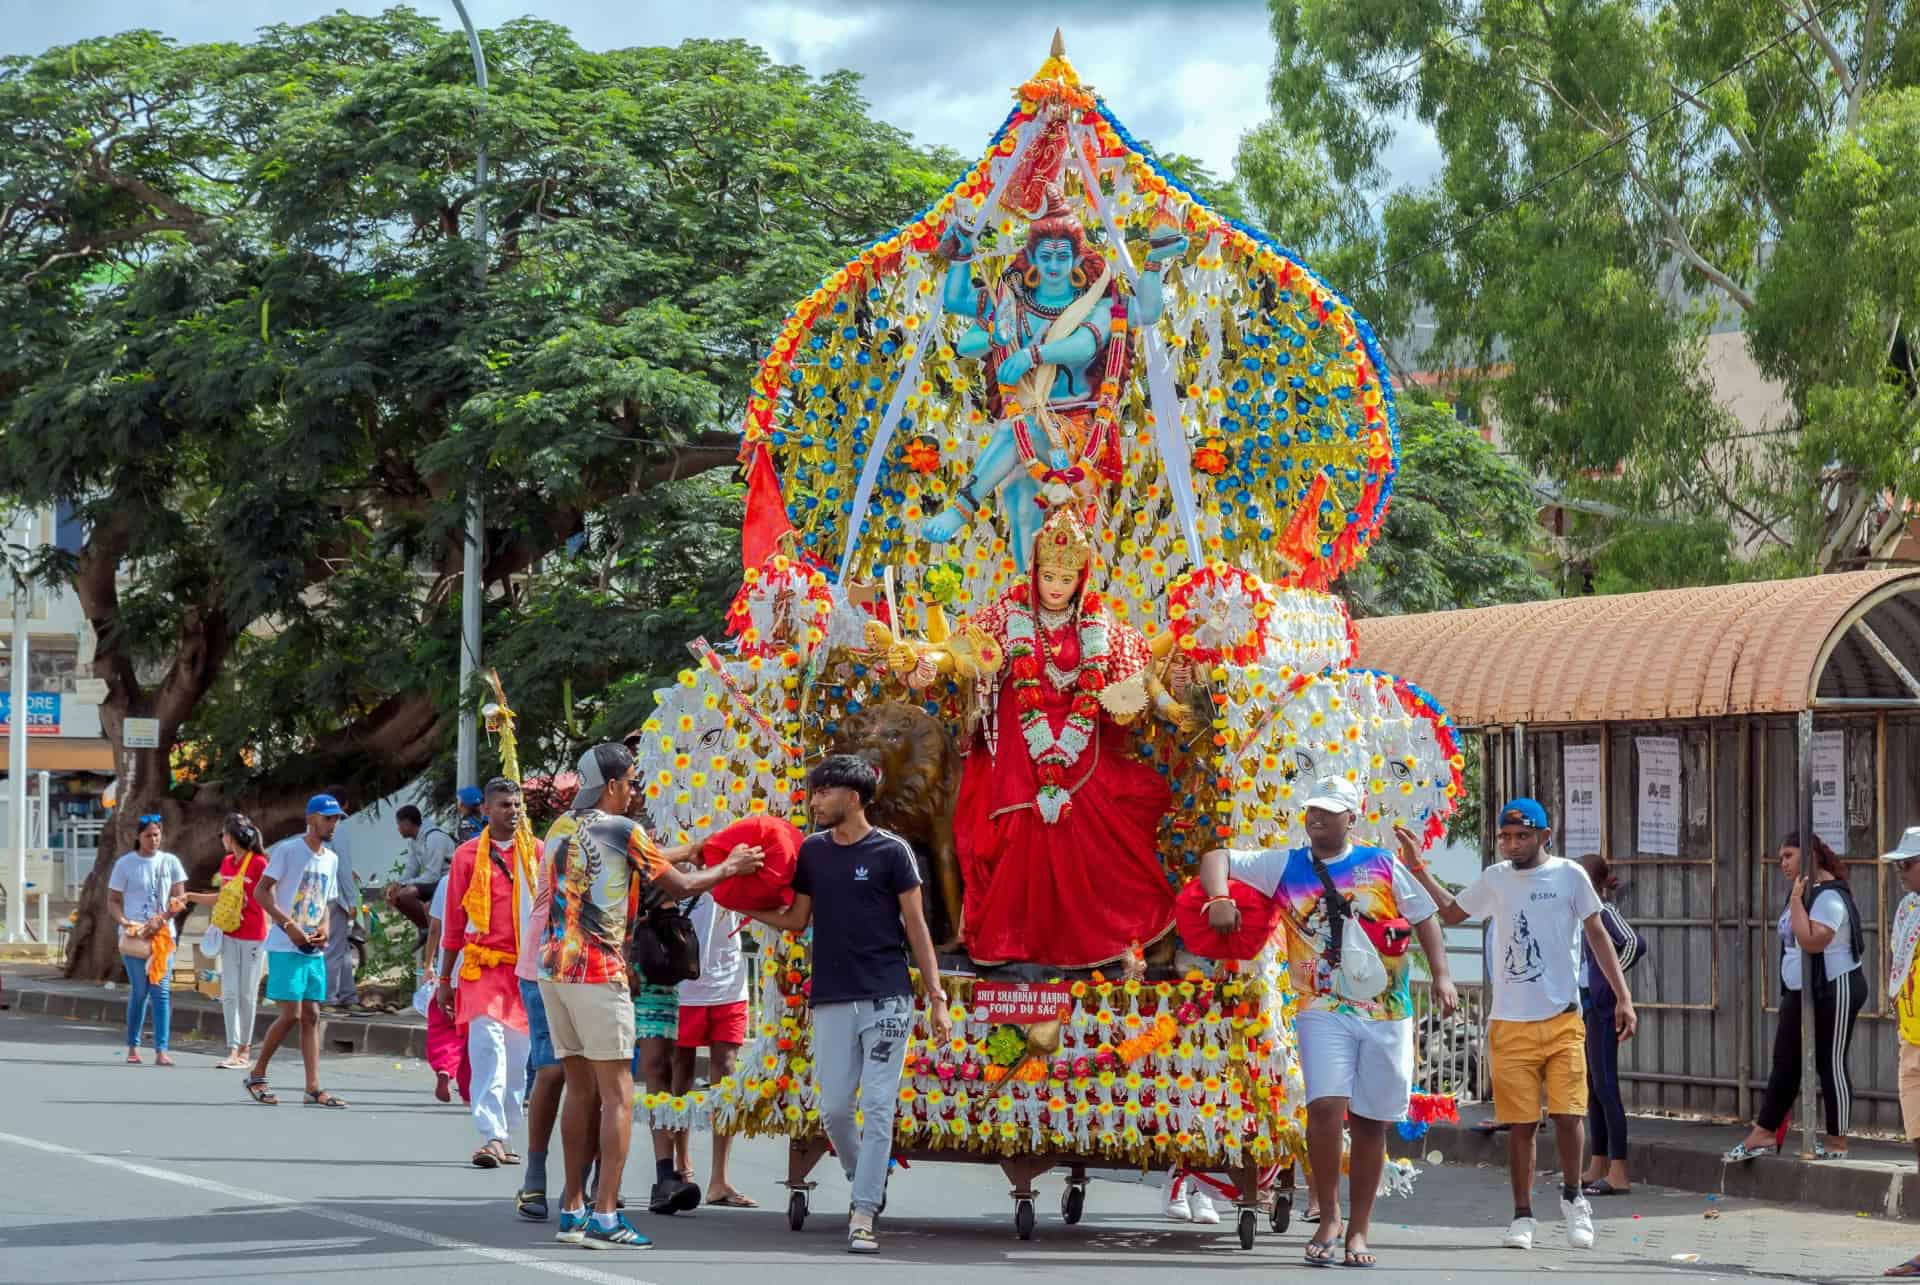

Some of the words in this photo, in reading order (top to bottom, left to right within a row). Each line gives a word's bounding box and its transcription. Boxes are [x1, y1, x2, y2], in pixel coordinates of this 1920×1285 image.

[989, 1003, 1016, 1015] FOND
[1020, 1003, 1034, 1015] DU
[1037, 1004, 1057, 1015] SAC
[874, 1017, 910, 1028] NEW
[880, 1029, 906, 1038] YORK
